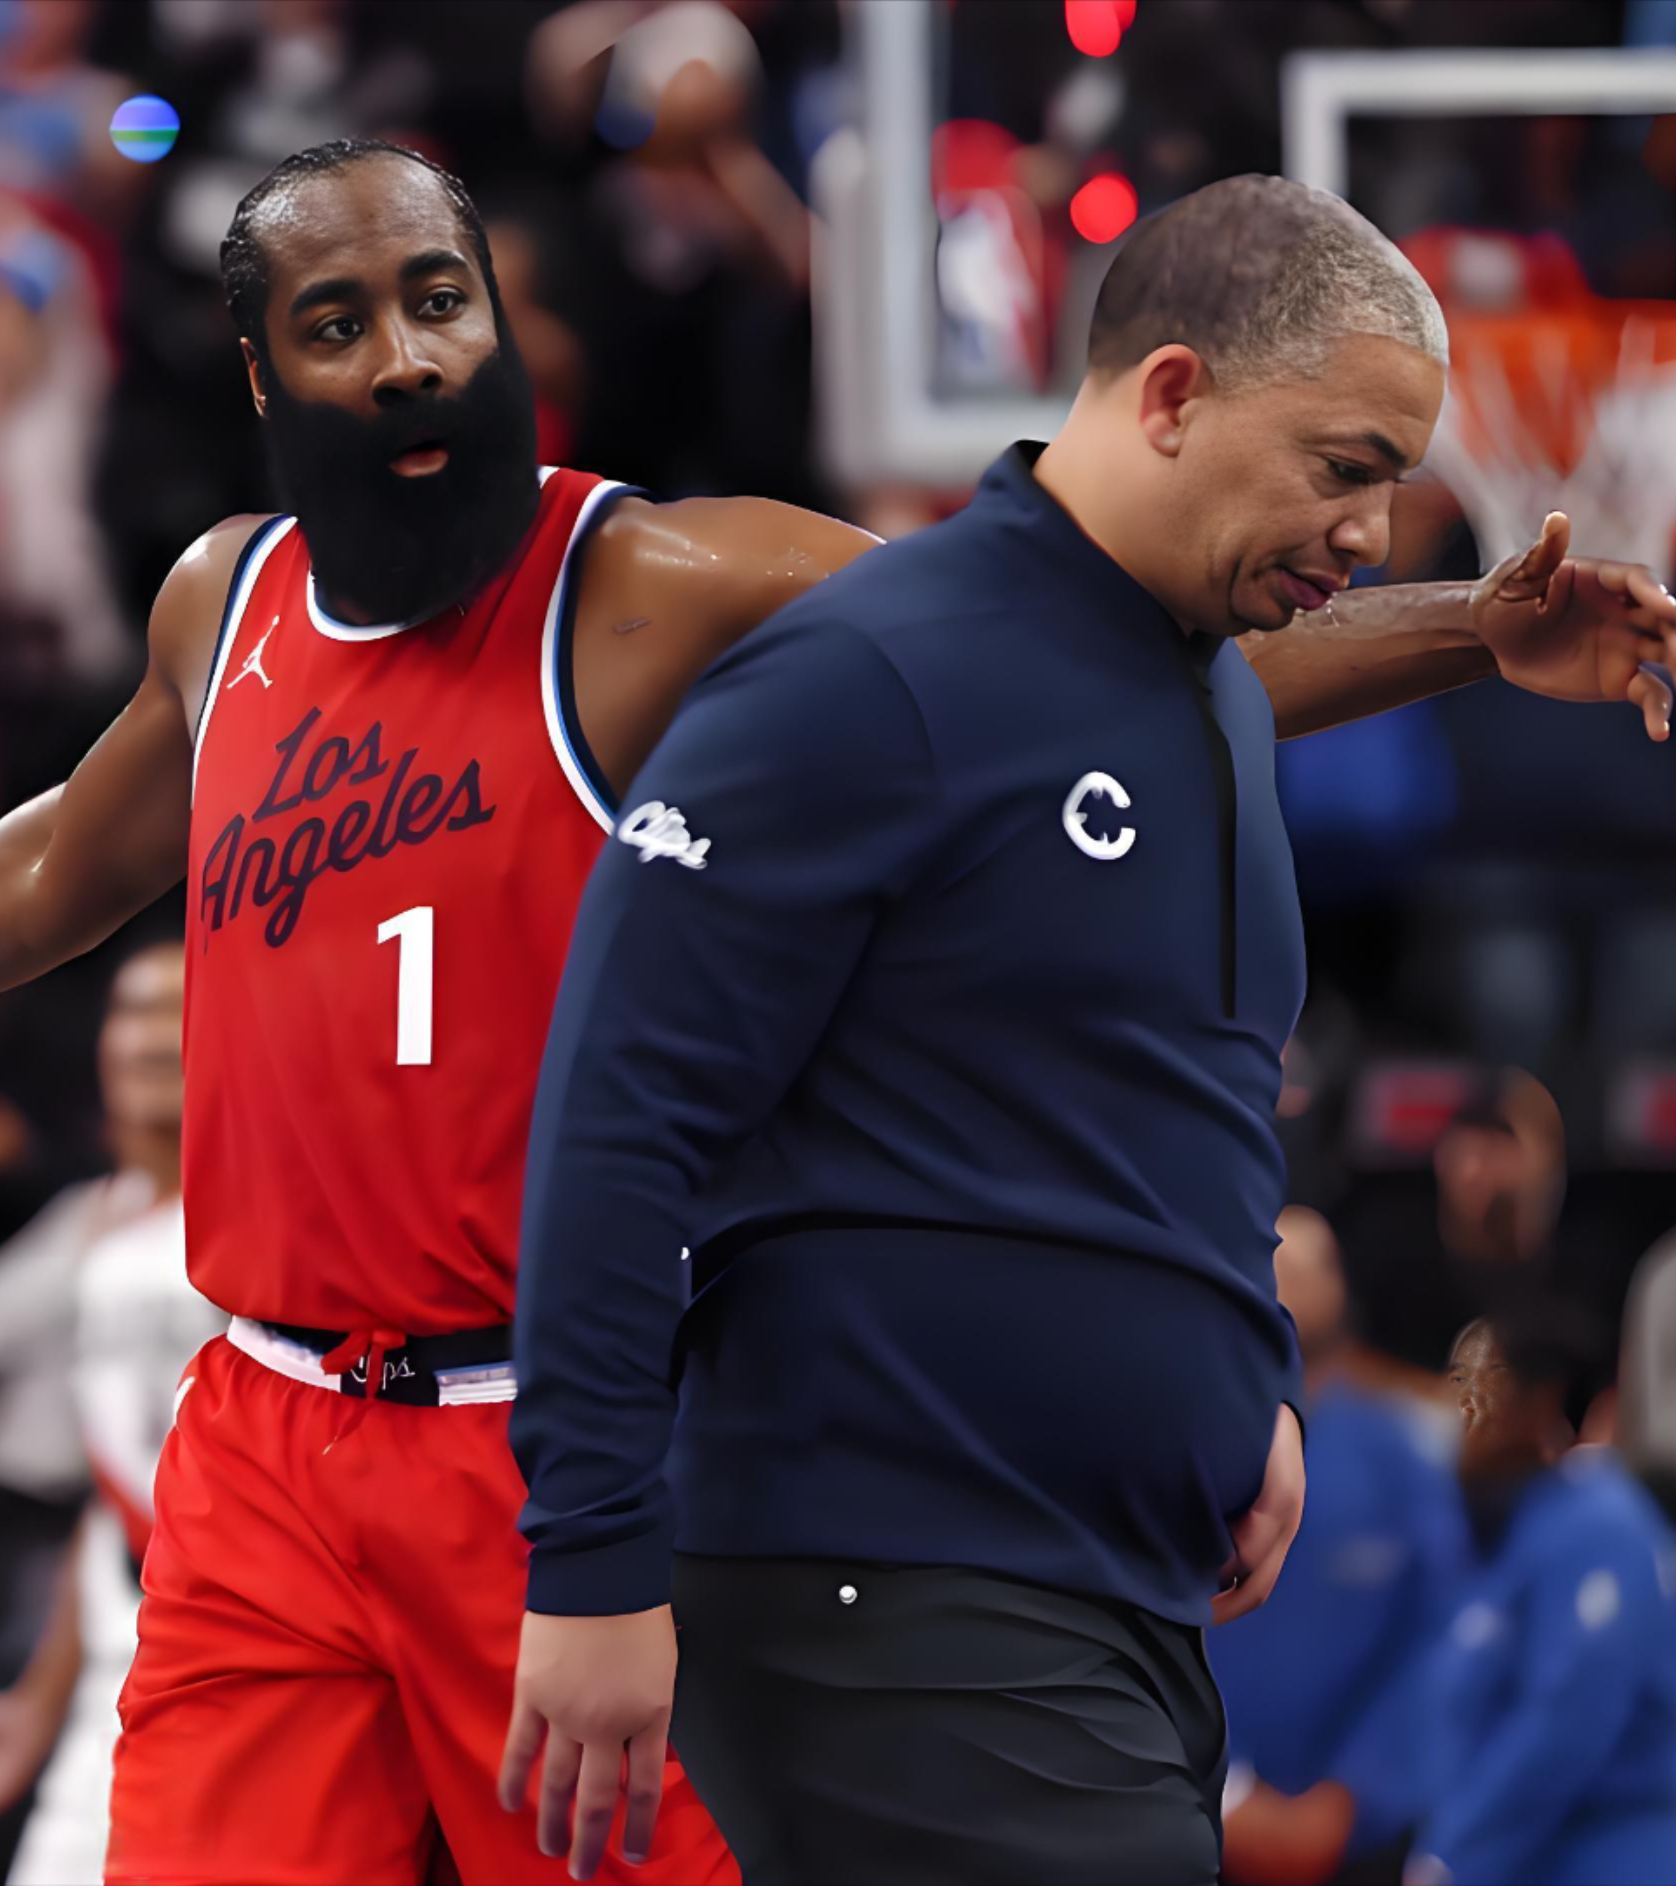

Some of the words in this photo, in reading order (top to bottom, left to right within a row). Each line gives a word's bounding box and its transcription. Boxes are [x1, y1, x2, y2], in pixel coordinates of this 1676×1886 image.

[252, 706, 391, 823] Los
[201, 758, 497, 955] Angeles
[377, 906, 433, 1066] 1
